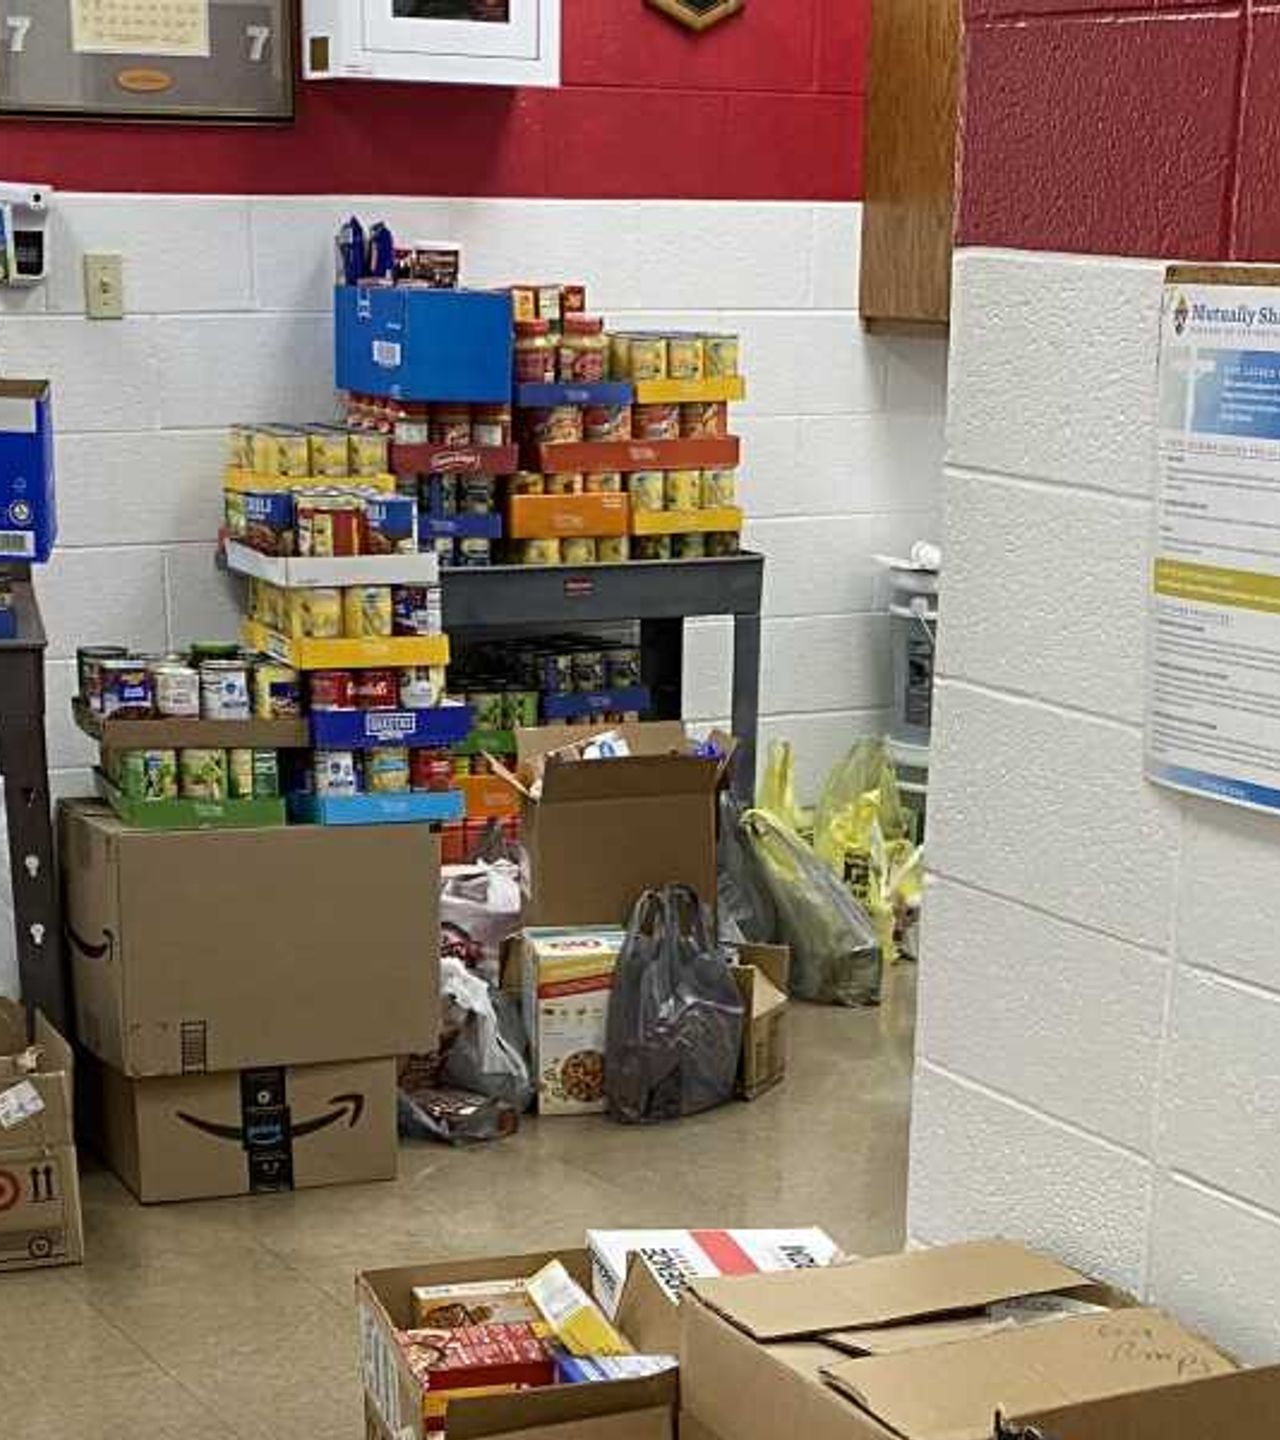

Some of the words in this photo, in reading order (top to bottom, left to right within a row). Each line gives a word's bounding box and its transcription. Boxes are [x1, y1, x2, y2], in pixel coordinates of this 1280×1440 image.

[7, 17, 31, 51] 7
[246, 26, 270, 60] 7
[1191, 303, 1256, 327] Mutually
